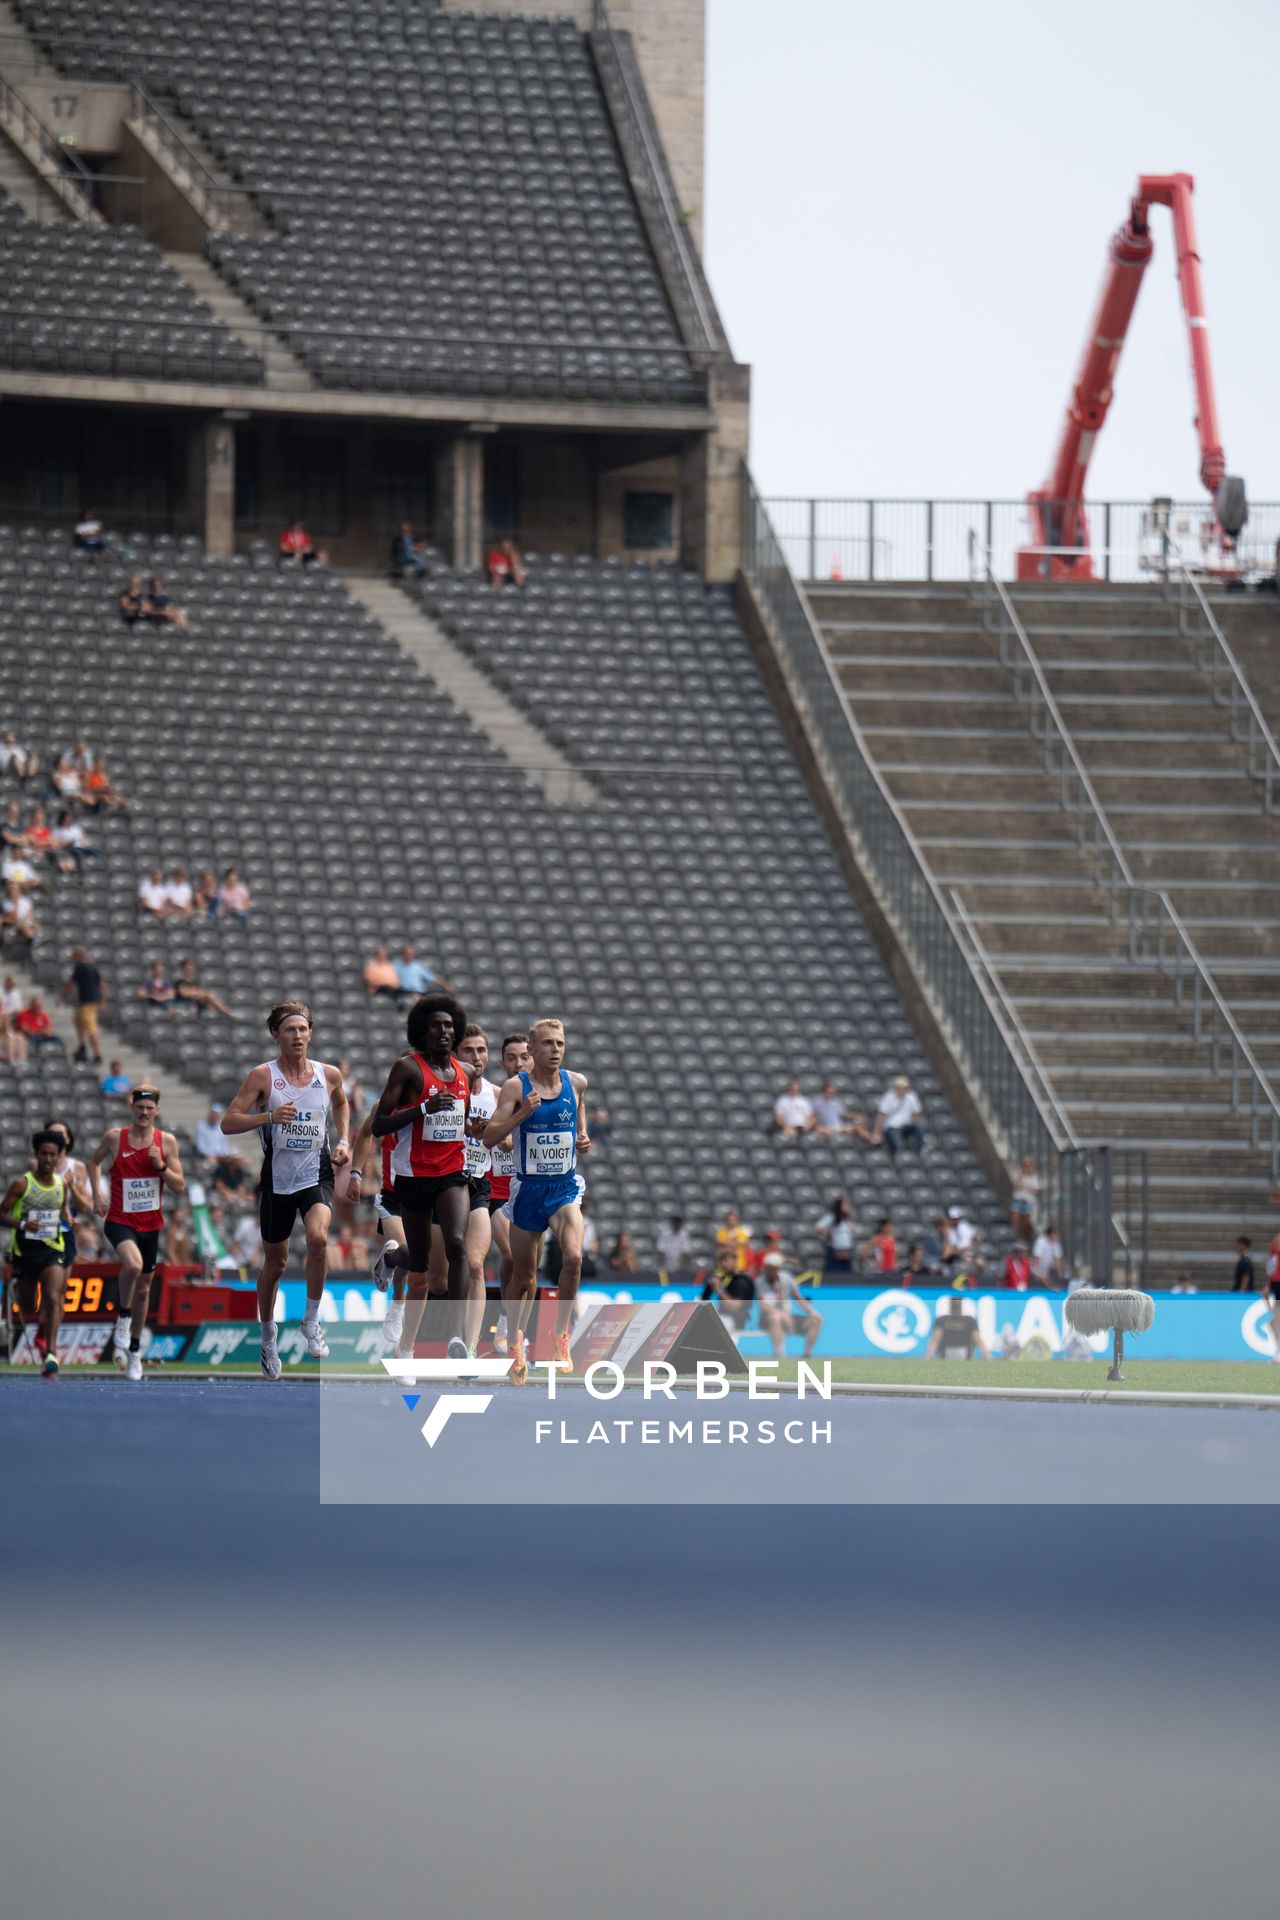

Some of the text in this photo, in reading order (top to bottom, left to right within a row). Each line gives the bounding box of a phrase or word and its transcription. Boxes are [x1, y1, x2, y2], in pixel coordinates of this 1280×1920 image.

[50, 96, 78, 119] 17
[281, 1124, 319, 1137] PARSONS
[536, 1134, 560, 1145] GLS
[529, 1147, 570, 1159] N. VOIGT
[131, 1180, 151, 1189] GLS
[127, 1190, 156, 1201] DAHLKE
